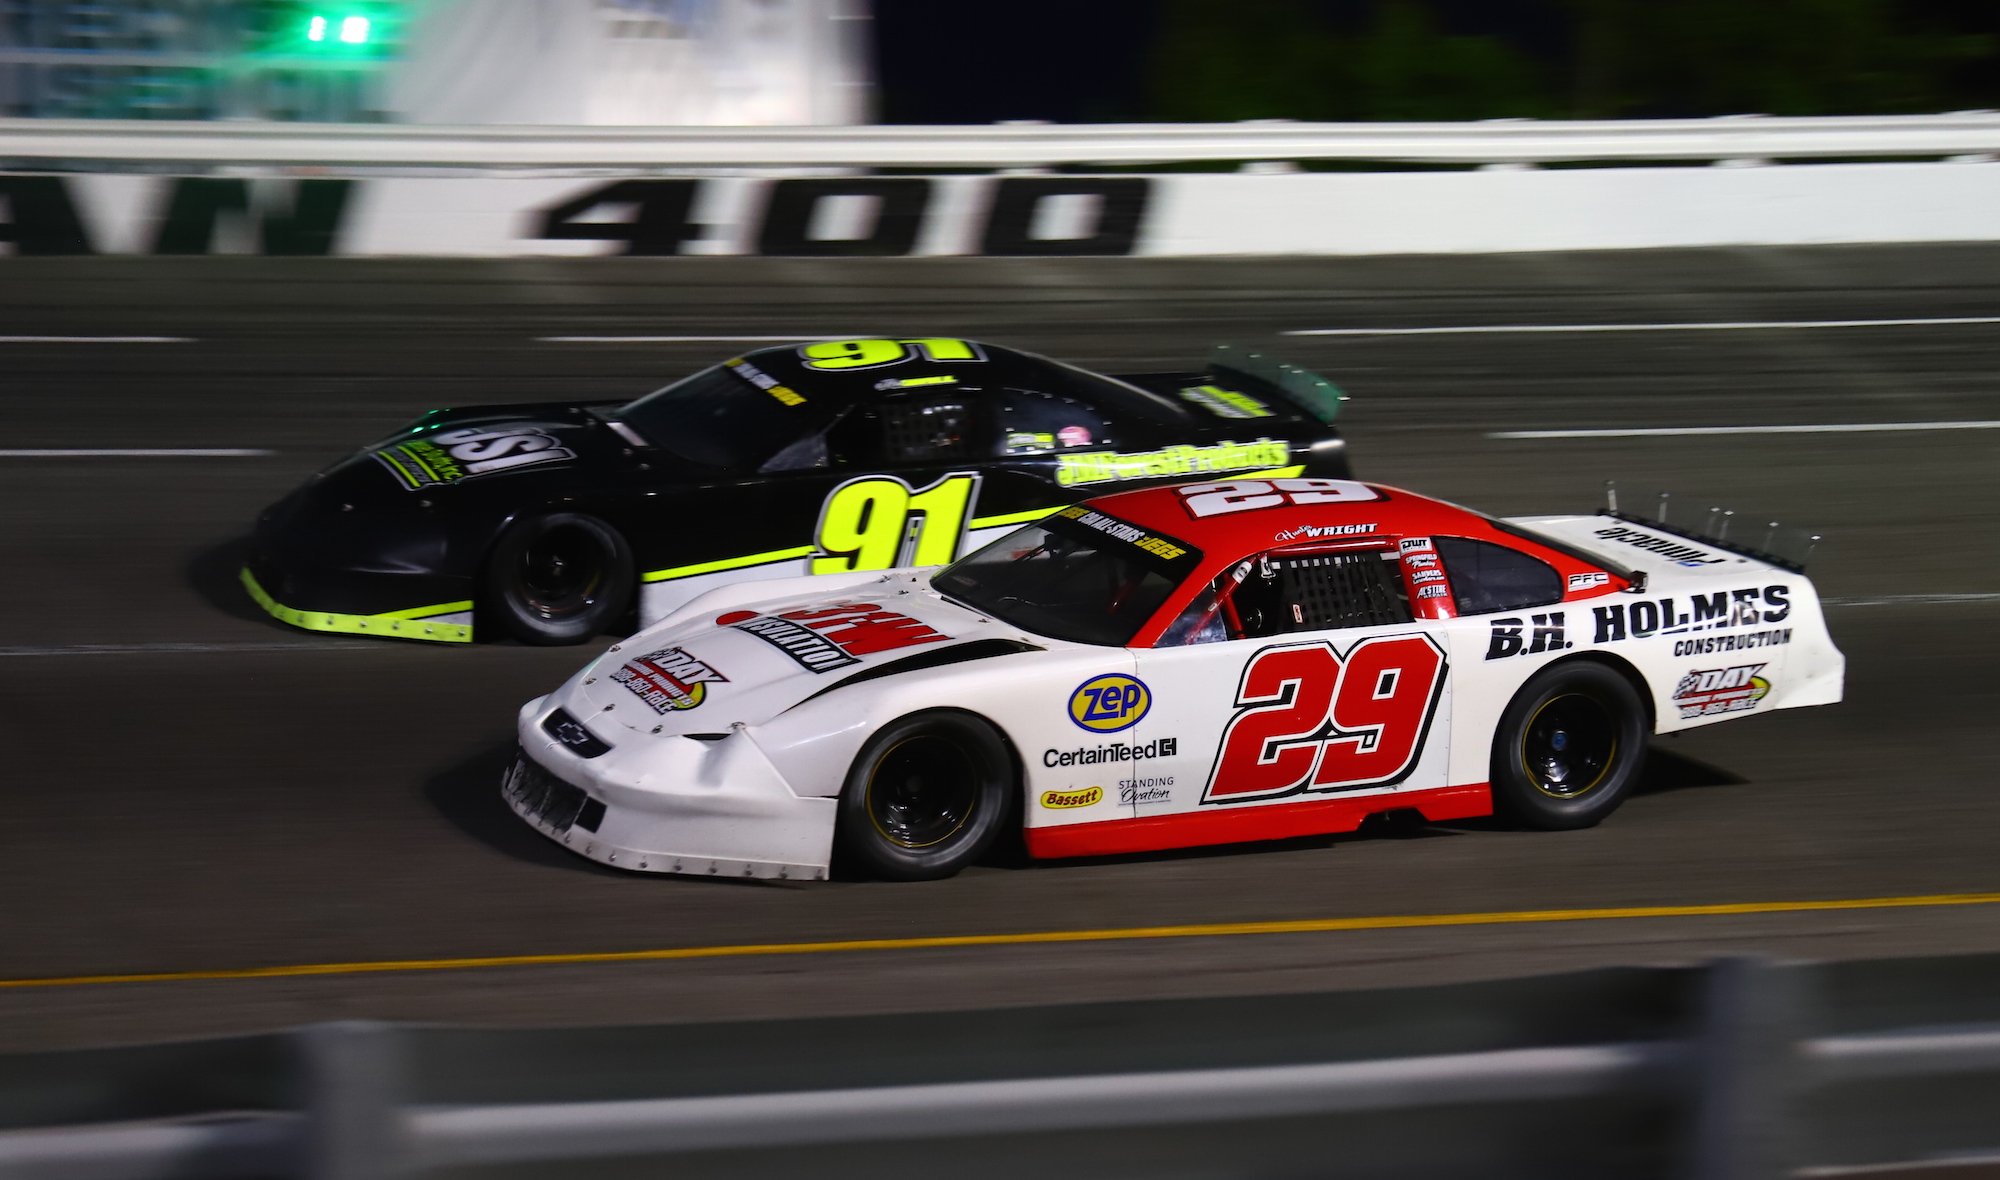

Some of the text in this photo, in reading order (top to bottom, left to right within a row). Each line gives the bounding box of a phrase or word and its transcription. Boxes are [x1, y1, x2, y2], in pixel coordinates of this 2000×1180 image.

[515, 178, 1150, 256] 400
[800, 337, 984, 371] 91
[1174, 480, 1388, 519] 29
[808, 472, 981, 576] 91
[1307, 523, 1378, 537] WRIGHT
[1134, 537, 1187, 560] JEGS
[1569, 573, 1608, 585] PFC
[1484, 585, 1790, 661] B.H. HOLMES
[1674, 628, 1793, 657] CONSTRUCTION
[650, 648, 730, 685] DAY
[1695, 662, 1768, 692] DAY
[1201, 633, 1448, 804] 29
[1043, 740, 1157, 768] CertainTeed
[1046, 789, 1098, 805] Bassett
[1118, 777, 1174, 790] STANDING
[1121, 787, 1170, 803] Ovation
